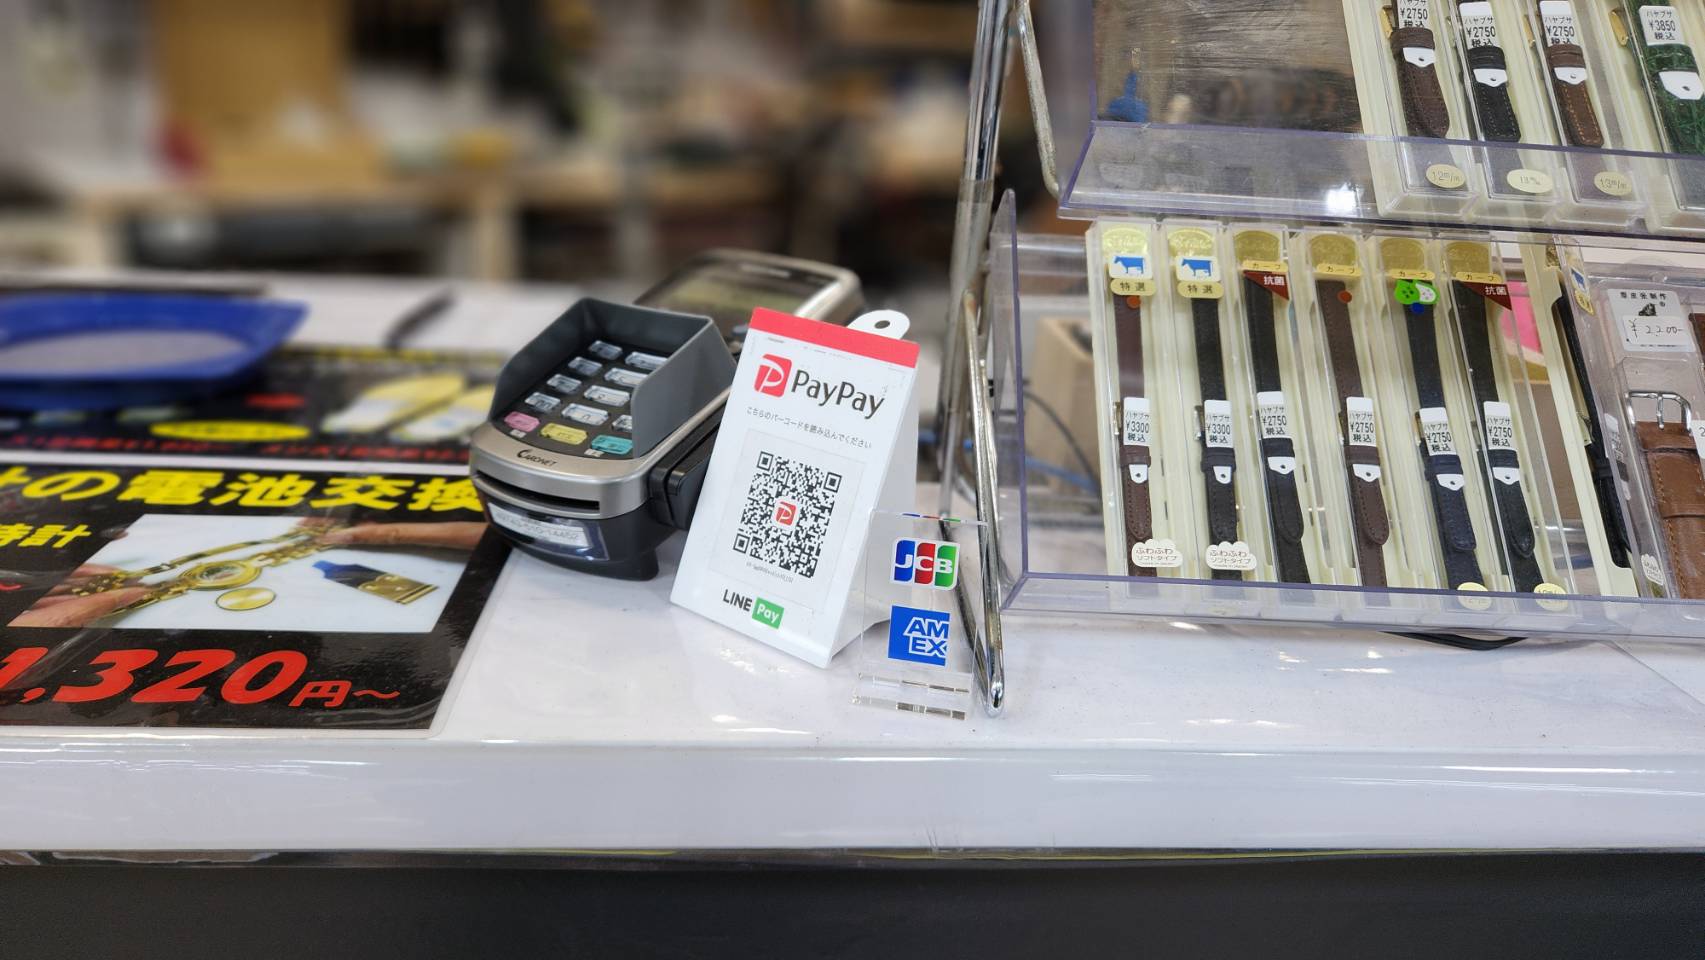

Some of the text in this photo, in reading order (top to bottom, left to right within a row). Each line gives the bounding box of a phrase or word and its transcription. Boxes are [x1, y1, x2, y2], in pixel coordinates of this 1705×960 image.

[1400, 8, 1428, 20] ¥2750
[1466, 26, 1496, 38] ¥2750
[1545, 25, 1575, 38] ¥2750
[1648, 20, 1676, 32] ¥3850
[1120, 281, 1146, 292] 特選
[1263, 275, 1285, 286] 抗菌
[1187, 284, 1213, 294] 特選
[1485, 286, 1507, 296] 抗菌
[791, 369, 885, 420] PayPay
[746, 406, 872, 449] こちらのバーコードを読み込んでください
[1125, 421, 1150, 434] ¥3300
[1262, 415, 1287, 427] ¥2750
[1349, 421, 1374, 434] ¥2750
[1206, 424, 1231, 436] ¥3300
[1487, 425, 1513, 438] ¥2750
[1426, 431, 1452, 444] ¥2750
[723, 588, 779, 624] LINE Pay
[903, 616, 950, 639] AM
[909, 635, 948, 658] EX
